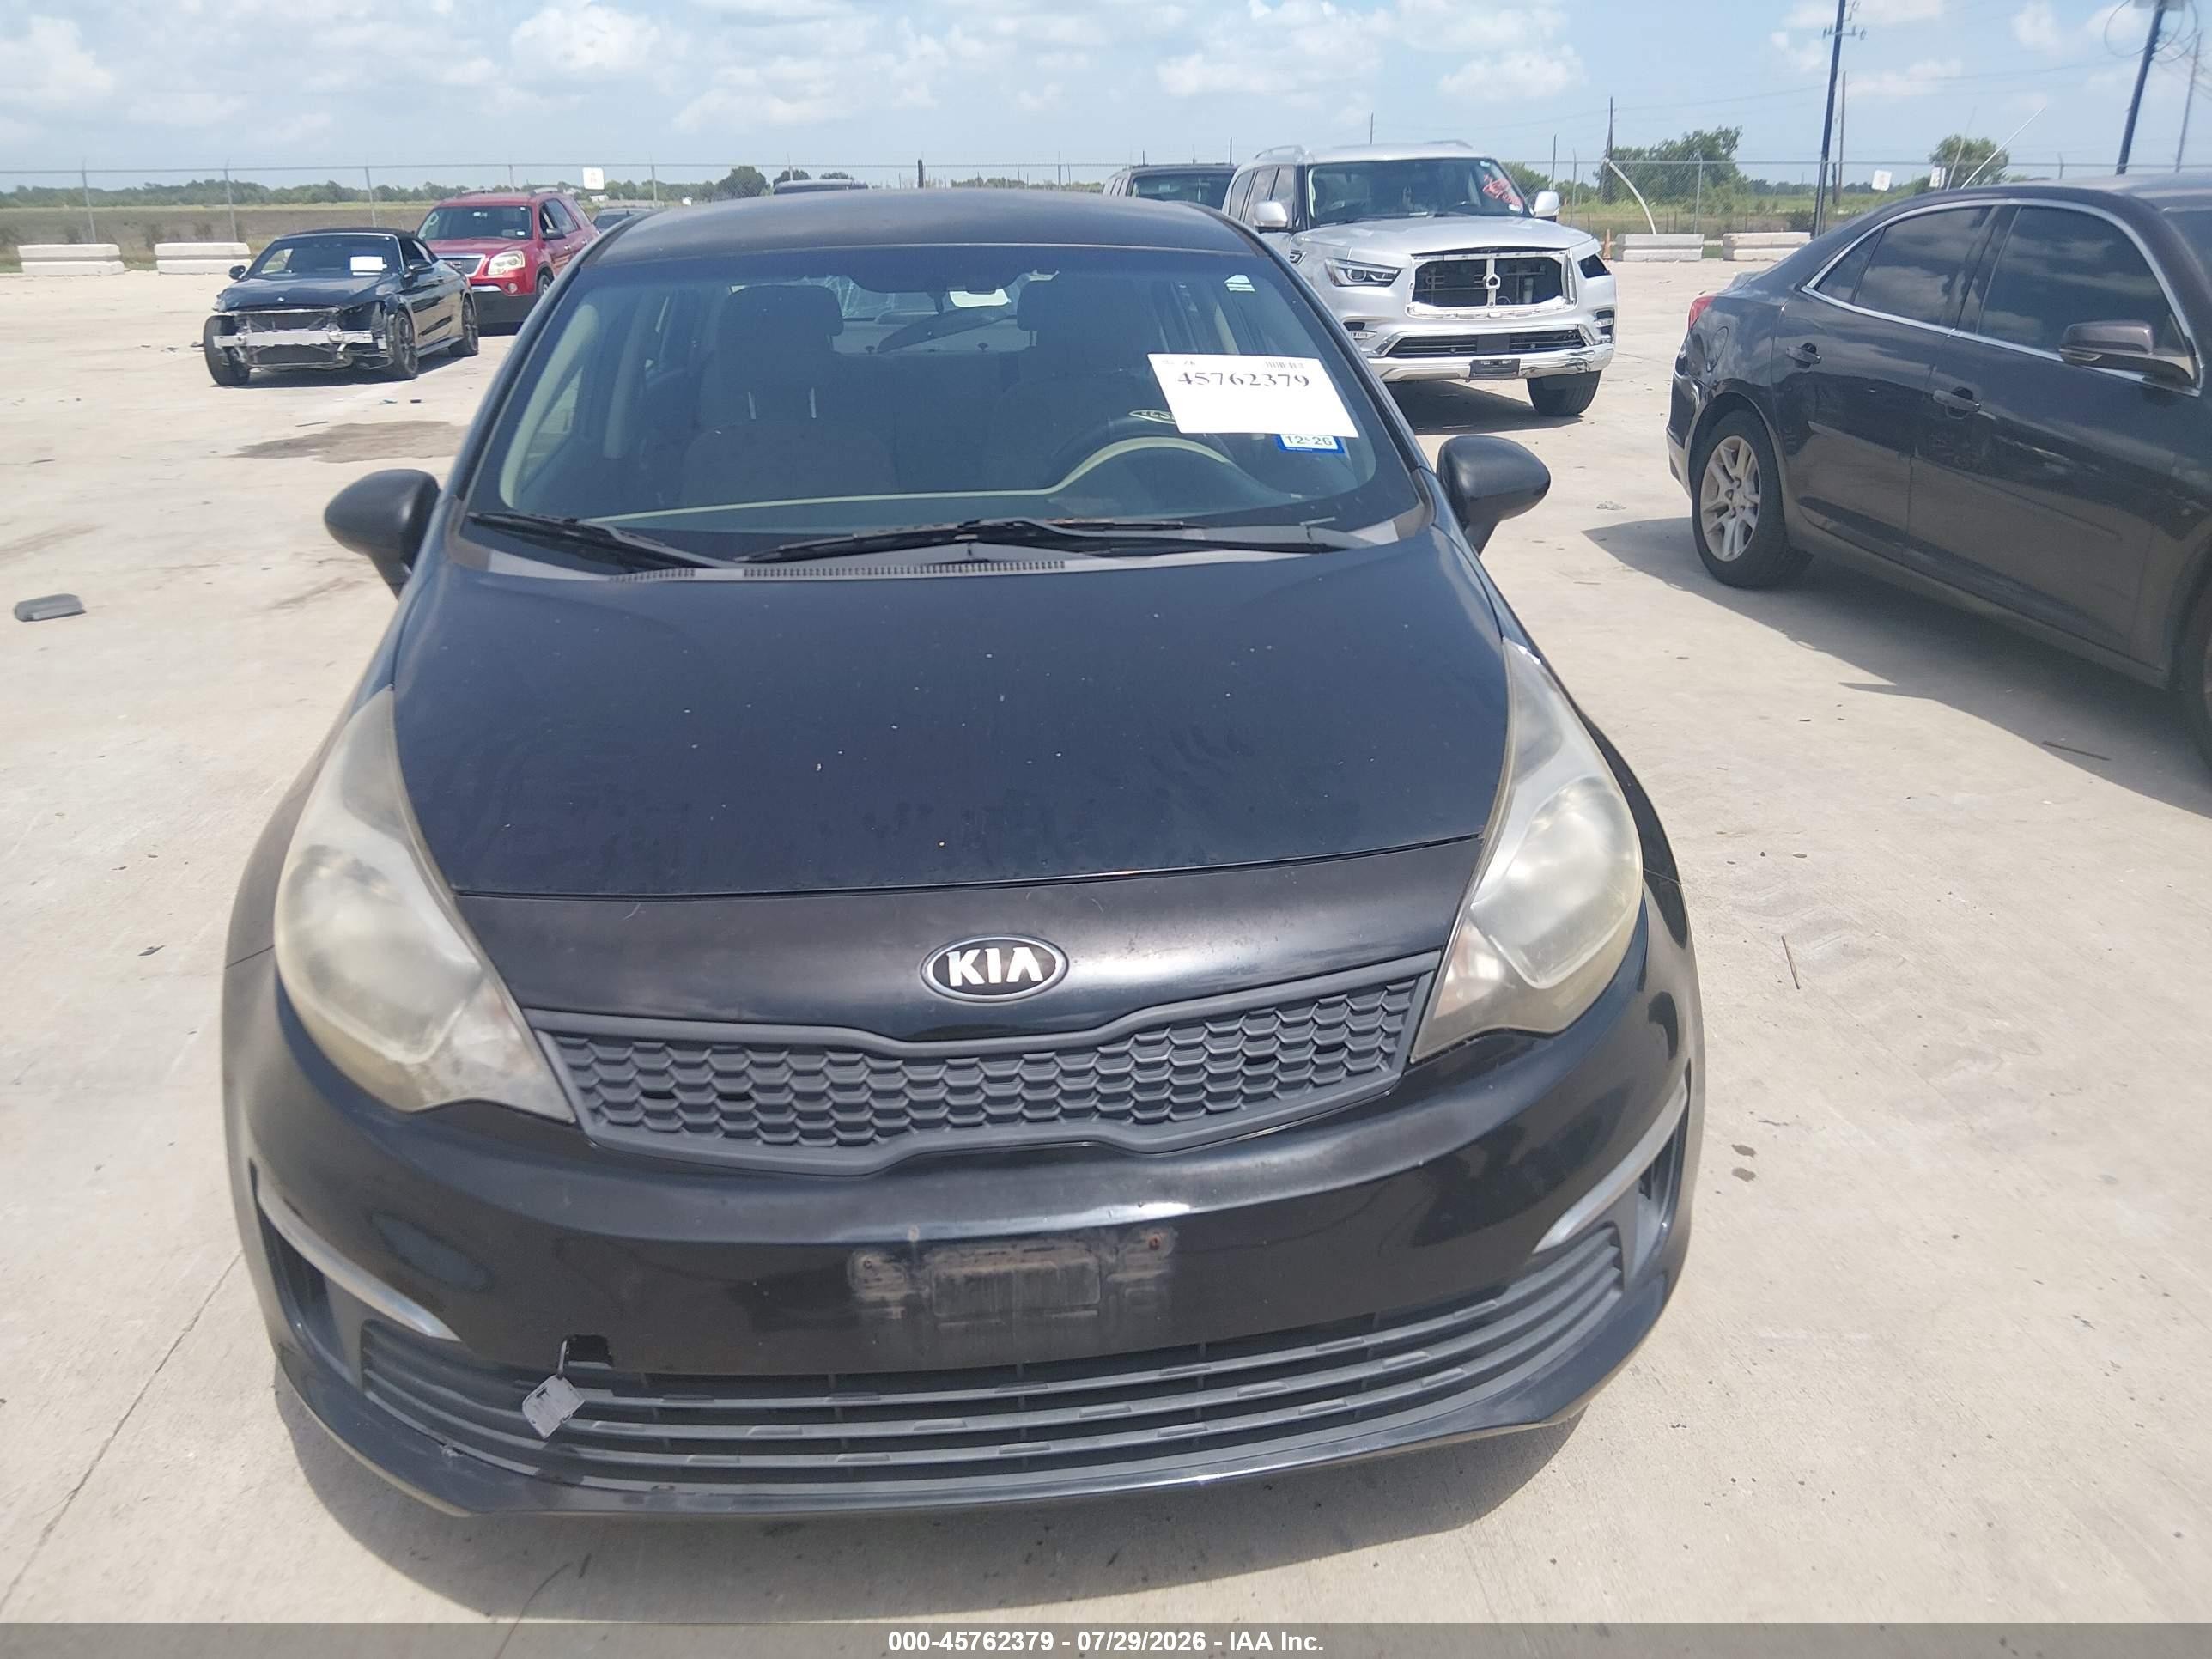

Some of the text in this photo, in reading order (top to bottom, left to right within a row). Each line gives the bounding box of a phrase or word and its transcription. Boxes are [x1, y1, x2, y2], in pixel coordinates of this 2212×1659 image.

[1177, 371, 1310, 387] 45762379
[1285, 434, 1333, 447] 12 26
[946, 946, 1044, 987] KIA
